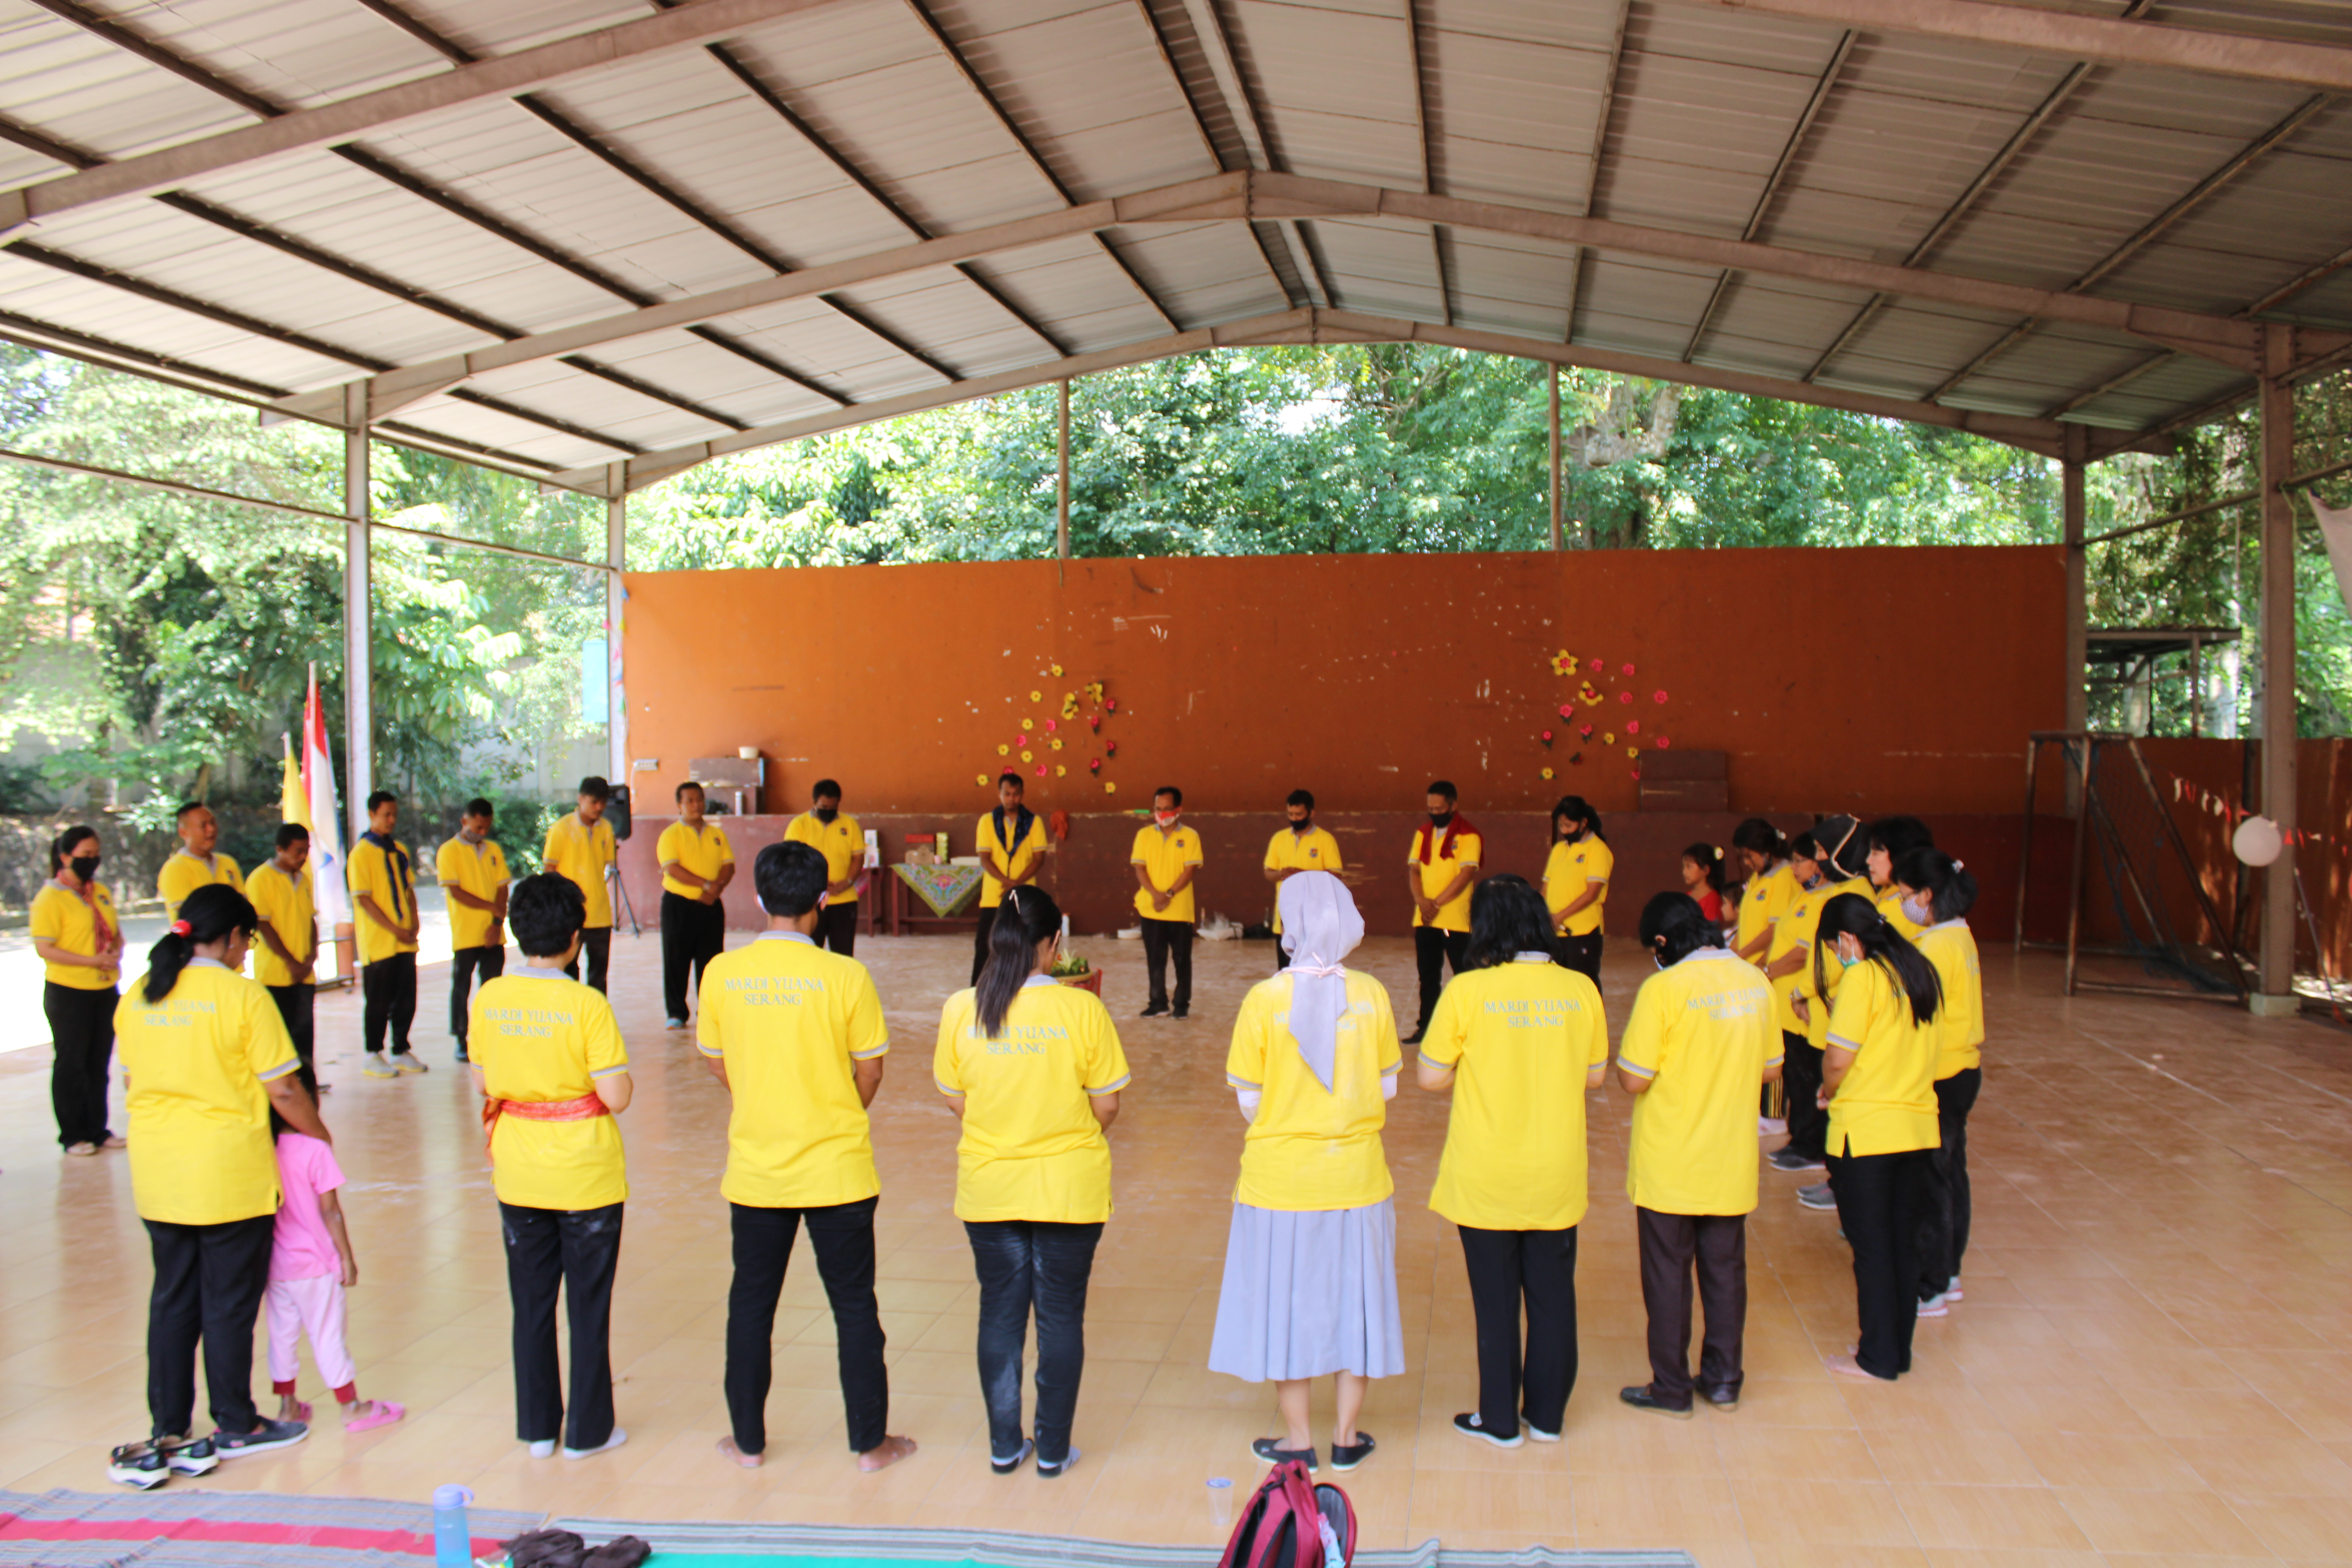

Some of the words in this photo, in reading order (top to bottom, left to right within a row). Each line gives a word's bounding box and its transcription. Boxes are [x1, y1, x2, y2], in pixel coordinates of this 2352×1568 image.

[725, 976, 769, 991] MARDI
[772, 976, 825, 992] YUANA
[173, 999, 216, 1014] YUANA
[744, 993, 802, 1005] SERANG
[1484, 999, 1529, 1014] MARDI
[1533, 998, 1582, 1013] YUANA
[1687, 992, 1726, 1011] MARDI
[484, 1007, 523, 1021] MARDI
[526, 1009, 574, 1025] YUANA
[1709, 1002, 1757, 1021] SERANG
[144, 1014, 193, 1026] SERANG
[1507, 1014, 1564, 1028] SERANG
[499, 1023, 553, 1038] SERANG
[967, 1025, 1011, 1039] MADI
[1014, 1026, 1069, 1039] YUANA
[986, 1041, 1045, 1054] SERANG
